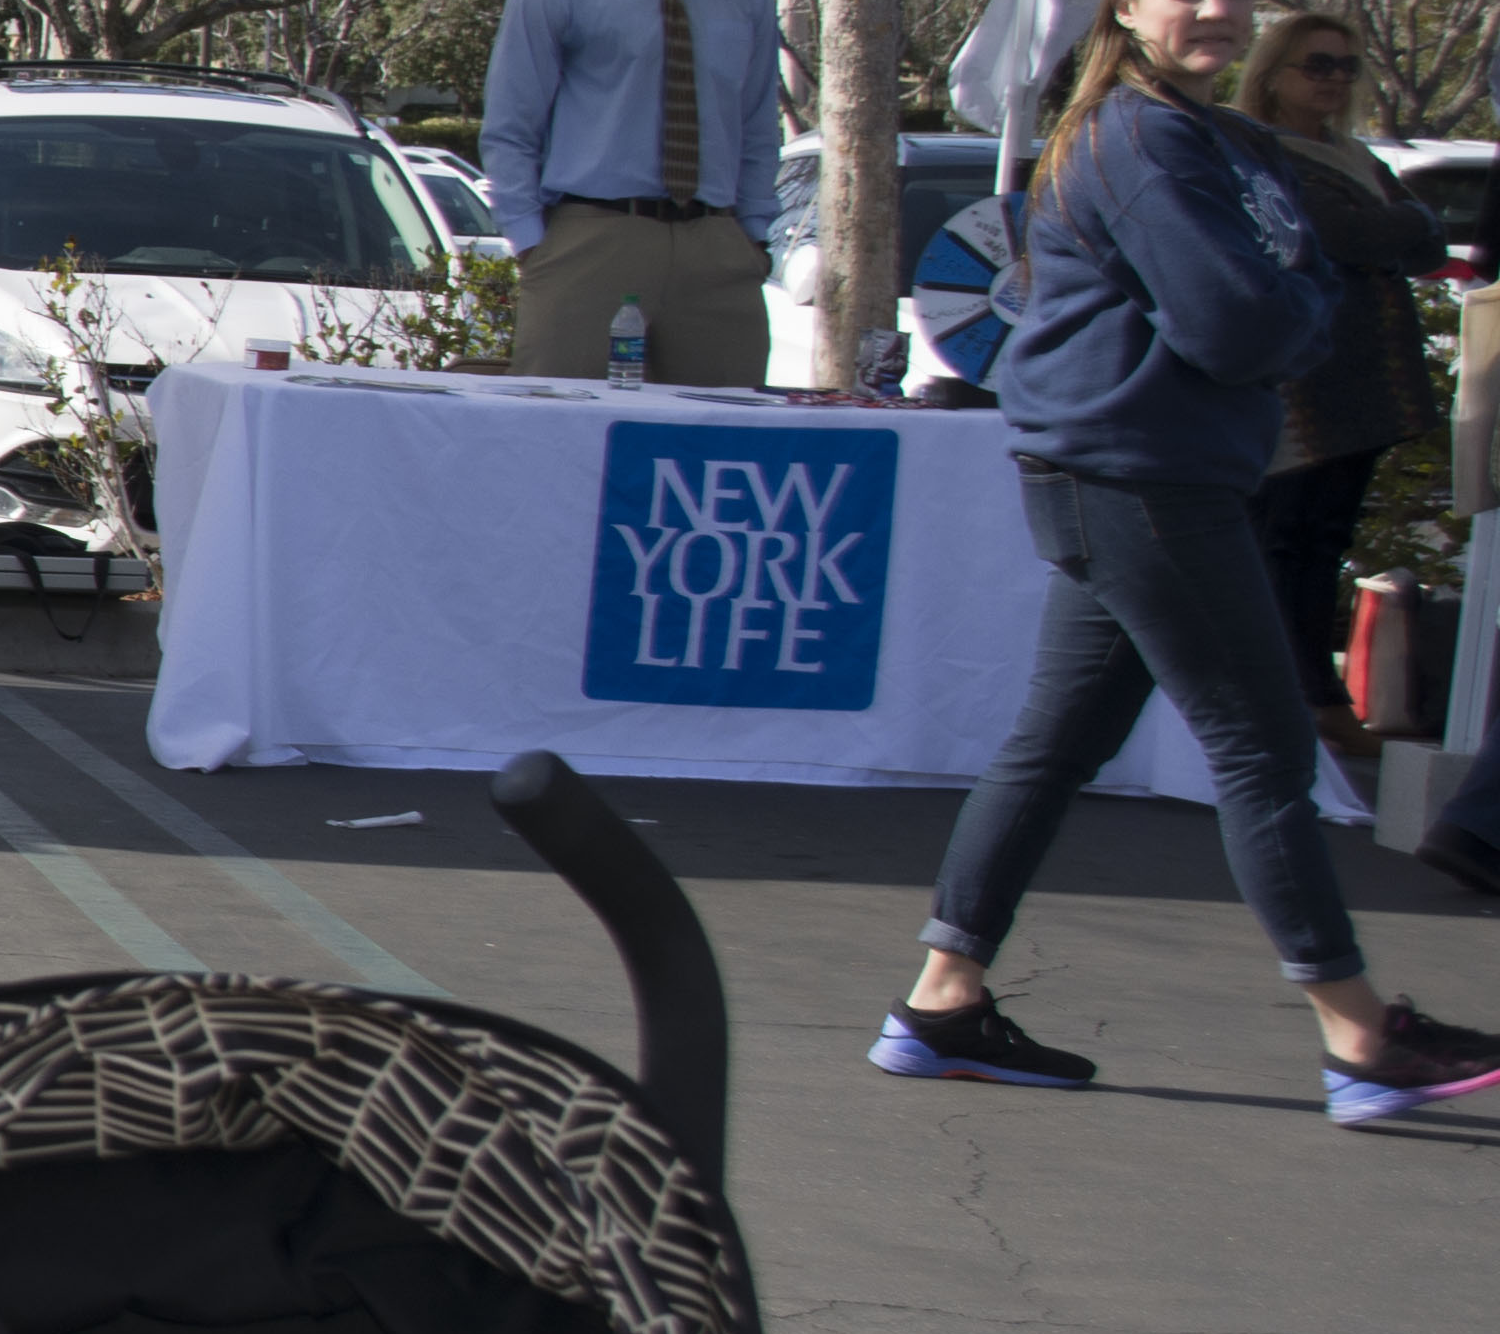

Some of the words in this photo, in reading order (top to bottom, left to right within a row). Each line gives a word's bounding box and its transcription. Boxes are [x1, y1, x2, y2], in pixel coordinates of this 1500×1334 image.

[645, 457, 854, 532] NEW
[609, 524, 865, 610] YORK
[633, 594, 827, 673] LIFE
